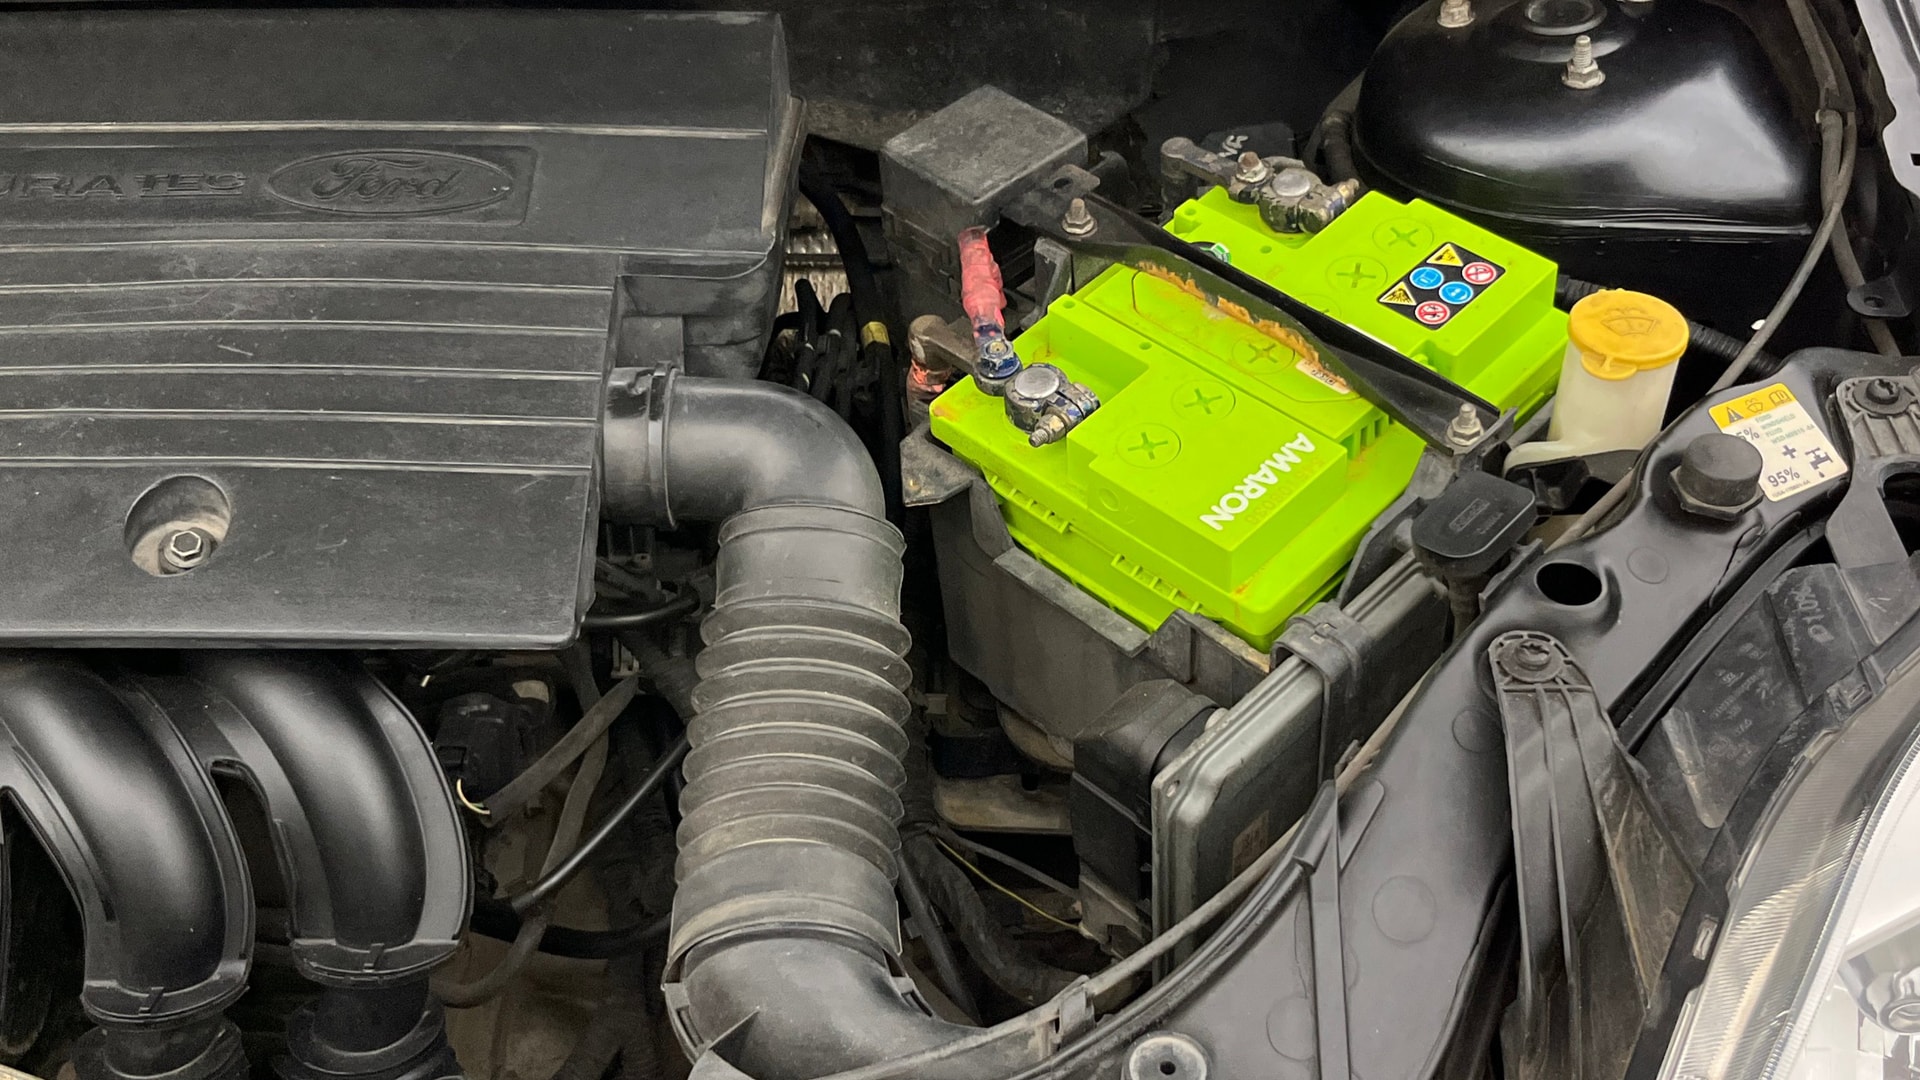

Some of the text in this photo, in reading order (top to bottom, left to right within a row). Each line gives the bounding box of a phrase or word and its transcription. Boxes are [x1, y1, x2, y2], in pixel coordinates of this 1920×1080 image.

[0, 172, 245, 201] RATEC
[311, 157, 463, 202] Ford
[1199, 432, 1316, 531] AMARON
[1767, 467, 1801, 488] 95%
